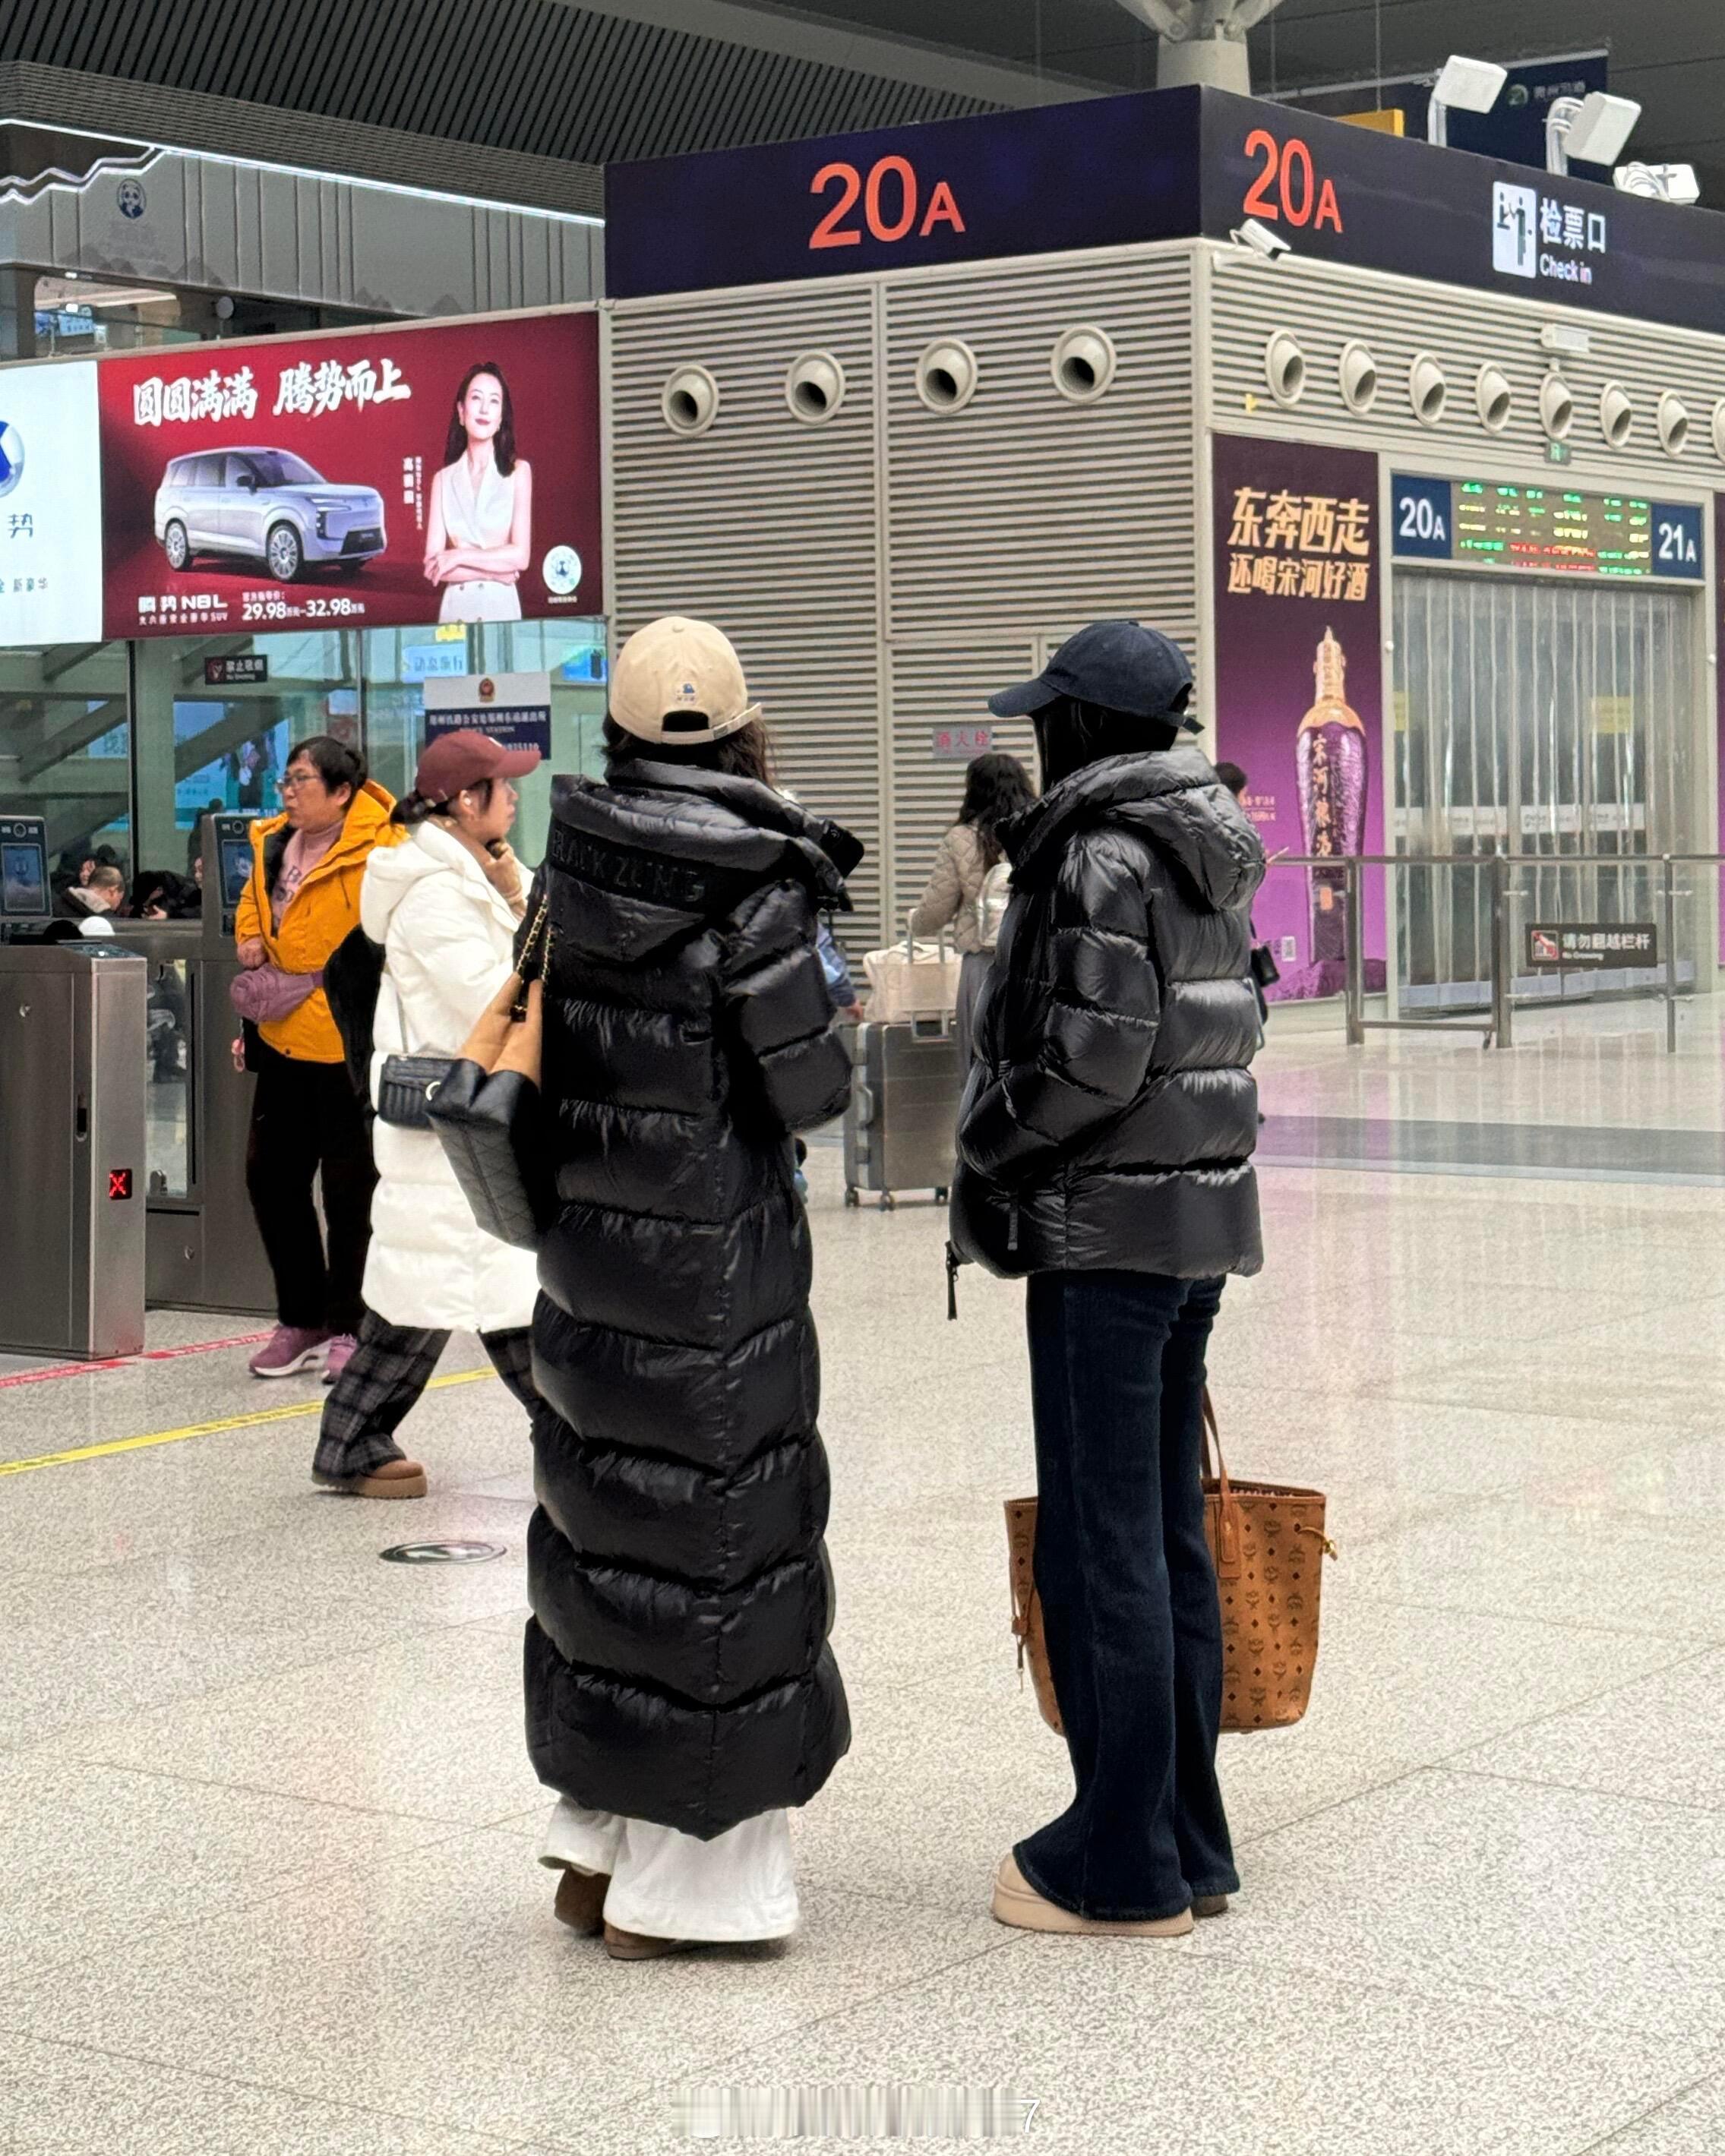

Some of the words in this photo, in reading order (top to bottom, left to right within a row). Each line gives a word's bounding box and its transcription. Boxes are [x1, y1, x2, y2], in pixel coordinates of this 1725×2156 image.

[809, 155, 965, 249] 20A
[1243, 130, 1343, 233] 20A
[1540, 197, 1606, 254] 检票口
[1540, 253, 1578, 282] Check
[1580, 261, 1592, 285] in
[134, 366, 257, 426] 圆圆满满
[273, 358, 411, 418] 腾势而上
[1227, 487, 1370, 556] 东奔西走
[1399, 497, 1446, 541] 20A
[1659, 523, 1696, 563] 21A
[1227, 553, 1370, 601] 还喝宋河好酒
